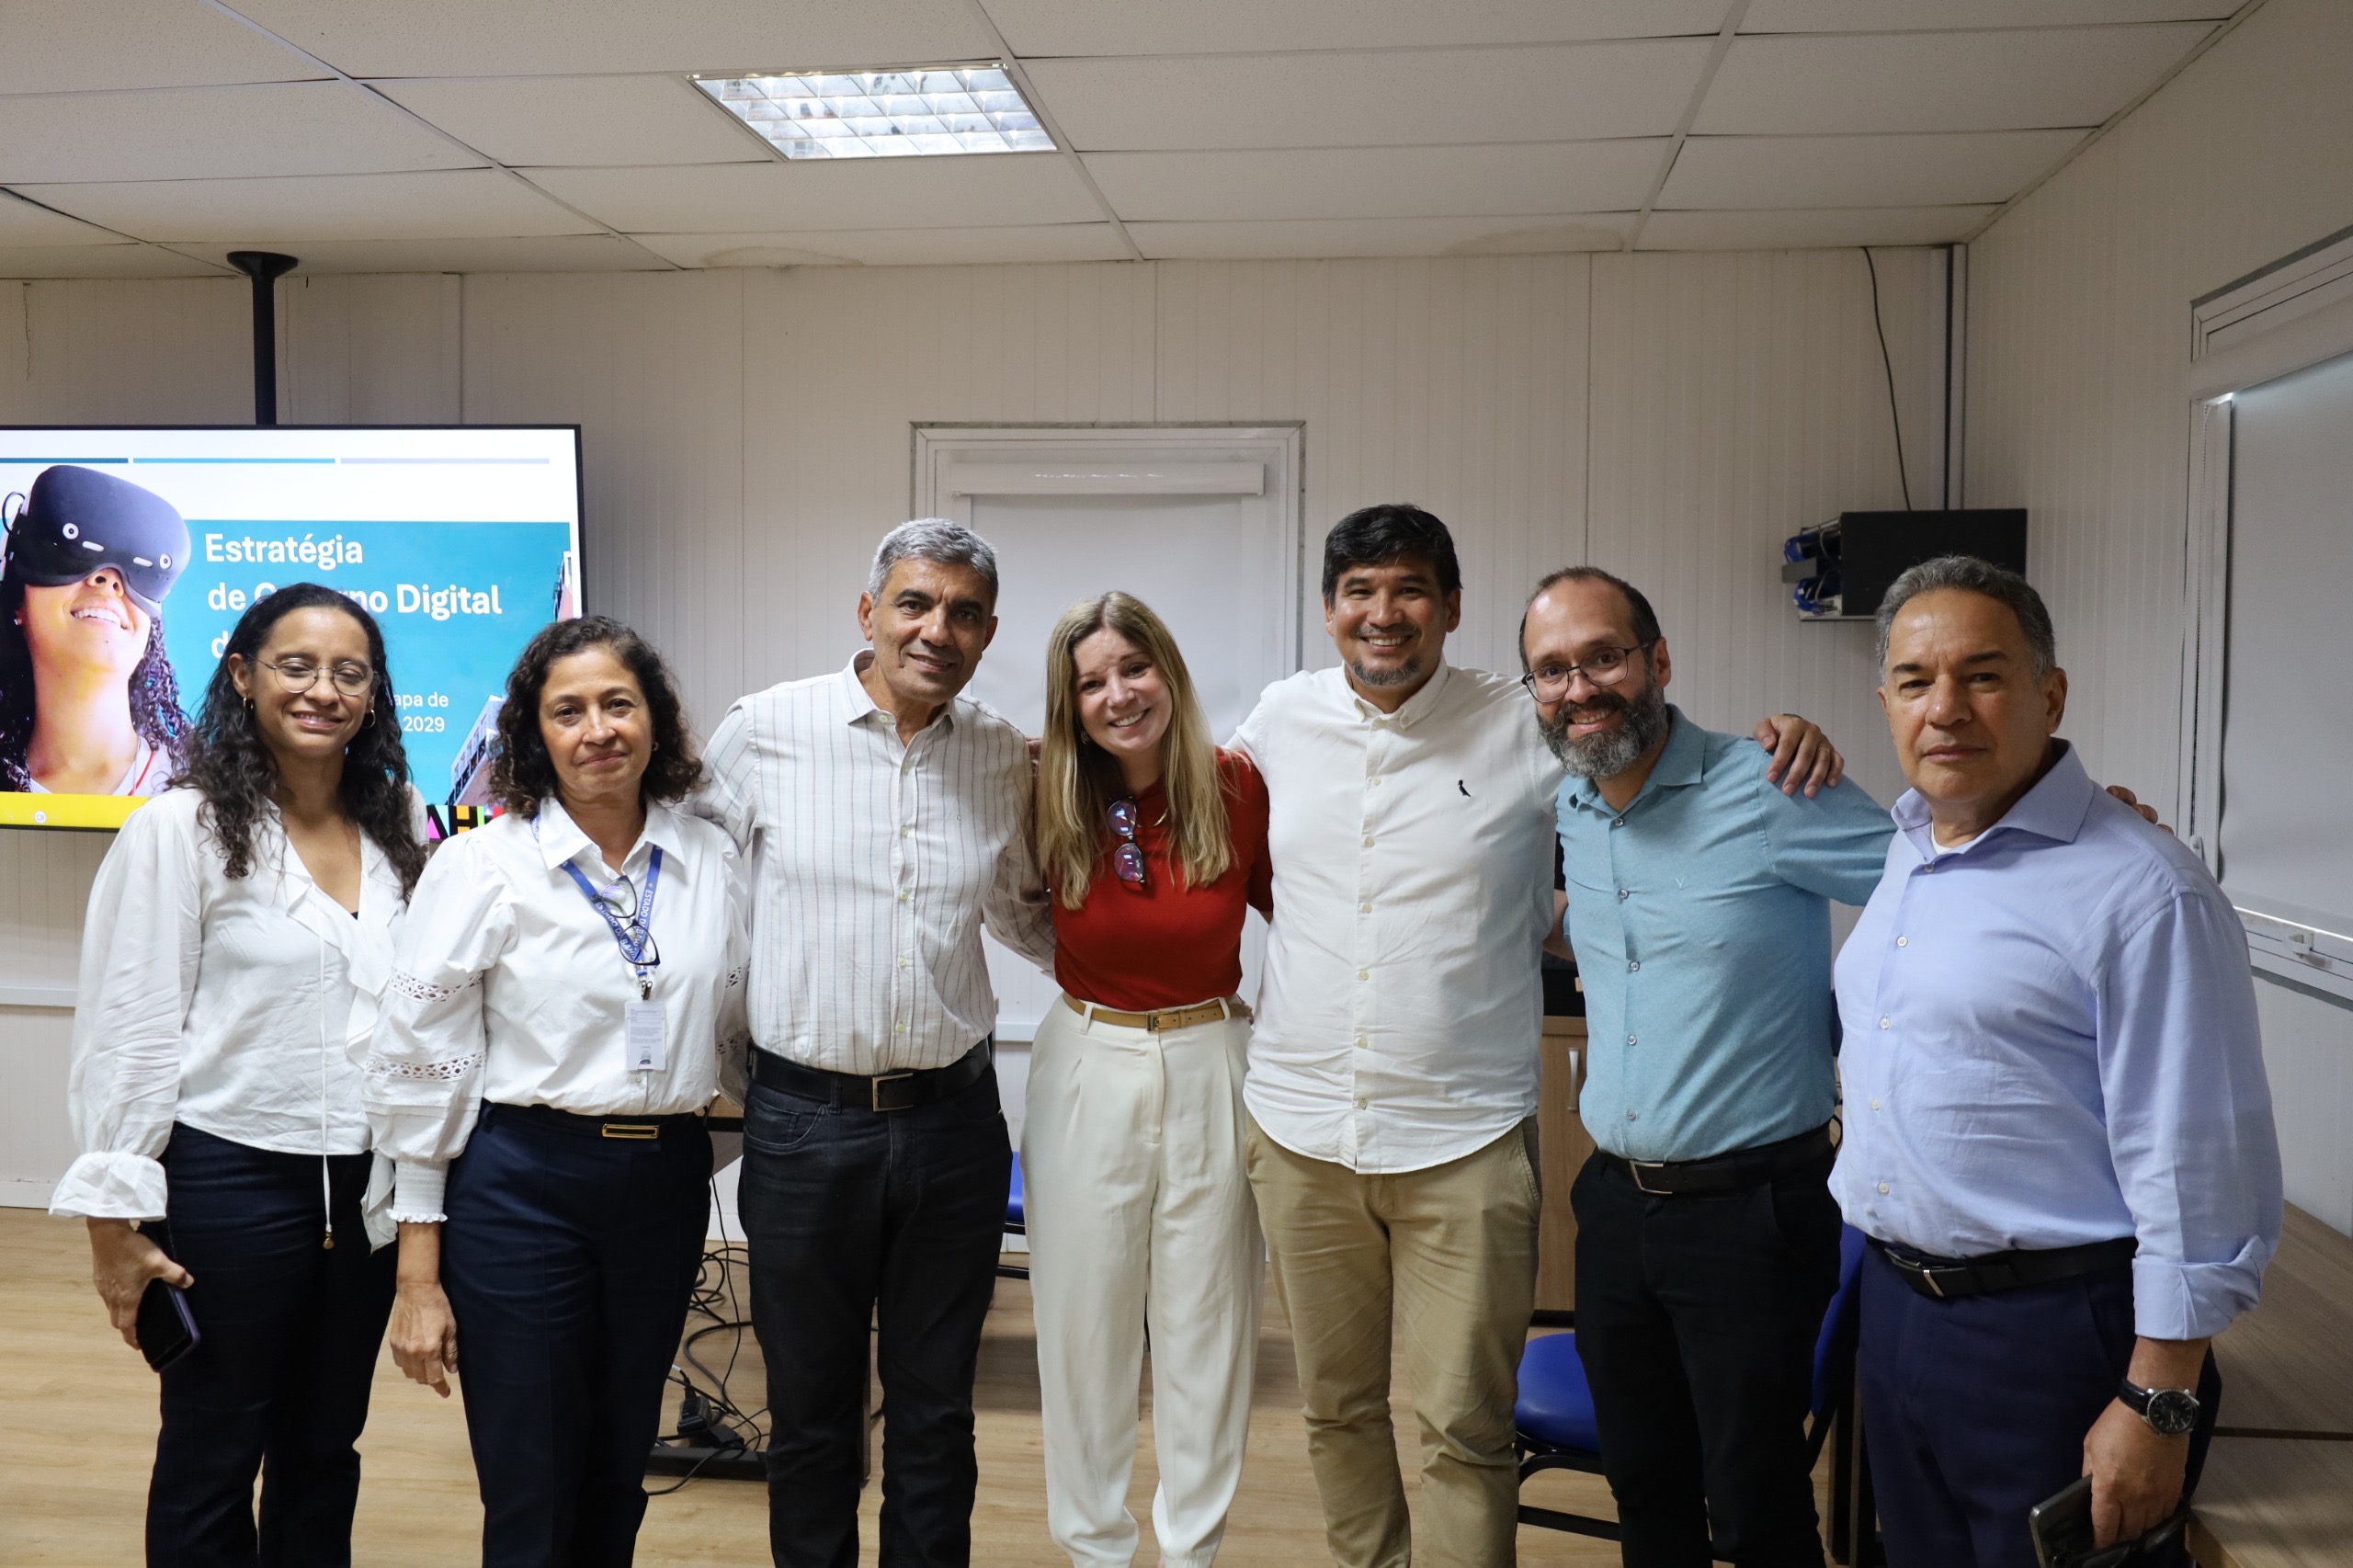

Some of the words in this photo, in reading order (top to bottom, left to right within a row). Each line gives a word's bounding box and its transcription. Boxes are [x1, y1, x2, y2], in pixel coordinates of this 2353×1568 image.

[205, 532, 363, 571] Estratégia
[208, 582, 246, 611] de
[396, 583, 502, 621] Digital
[392, 694, 423, 710] apa
[427, 691, 449, 708] de
[403, 715, 445, 733] 2029
[641, 890, 653, 917] ESTADO
[620, 938, 636, 957] BAH
